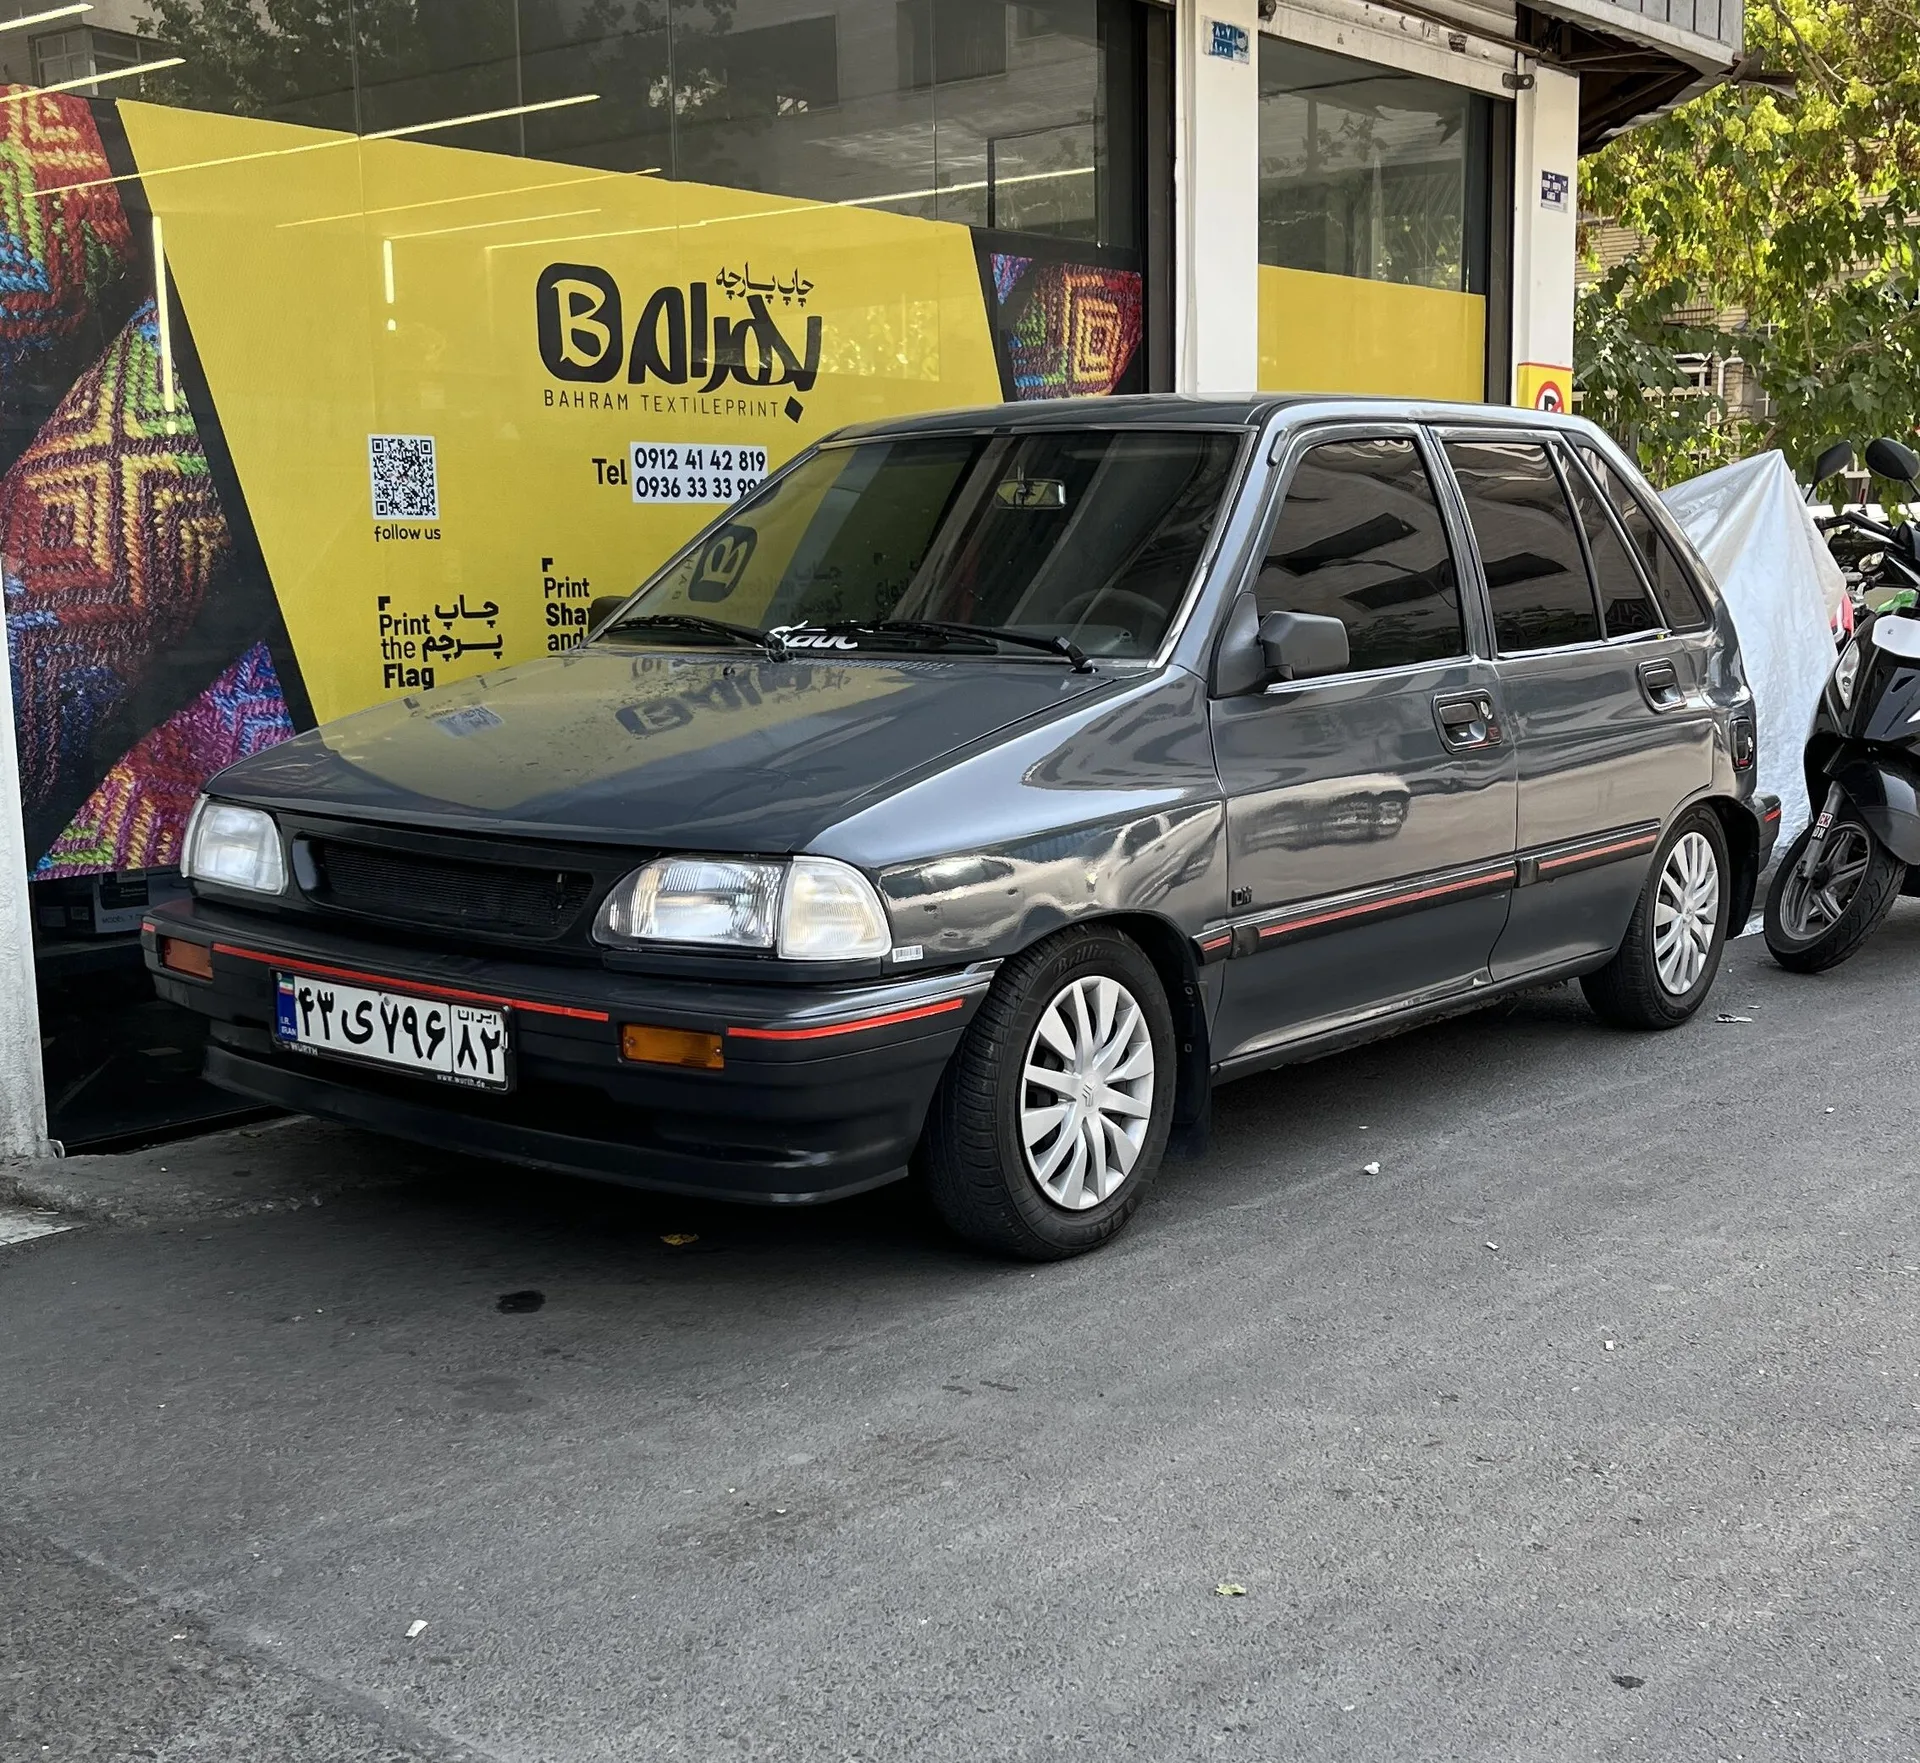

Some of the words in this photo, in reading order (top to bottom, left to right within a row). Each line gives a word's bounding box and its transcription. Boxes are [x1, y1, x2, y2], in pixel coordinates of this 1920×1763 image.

[715, 262, 776, 304] پارچه
[777, 268, 814, 307] چاپ
[544, 389, 629, 411] BAHRAM
[640, 394, 778, 418] TEXTILEPRINT
[592, 458, 628, 486] Tel
[635, 448, 679, 470] 0912
[685, 449, 703, 470] 41
[710, 450, 733, 471] 42
[739, 451, 766, 472] 819
[636, 476, 682, 498] 0936
[687, 477, 707, 498] 33
[713, 477, 732, 499] 33
[737, 478, 764, 499] 99
[374, 524, 421, 542] follow
[425, 528, 441, 540] us
[543, 576, 590, 599] Print
[434, 594, 499, 630] چاپ
[379, 612, 431, 637] Print
[381, 636, 416, 660] the
[422, 634, 503, 662] پرچم
[547, 627, 584, 651] and
[384, 663, 435, 691] Flag
[457, 1009, 497, 1026] ایران
[281, 1025, 297, 1036] IRAN
